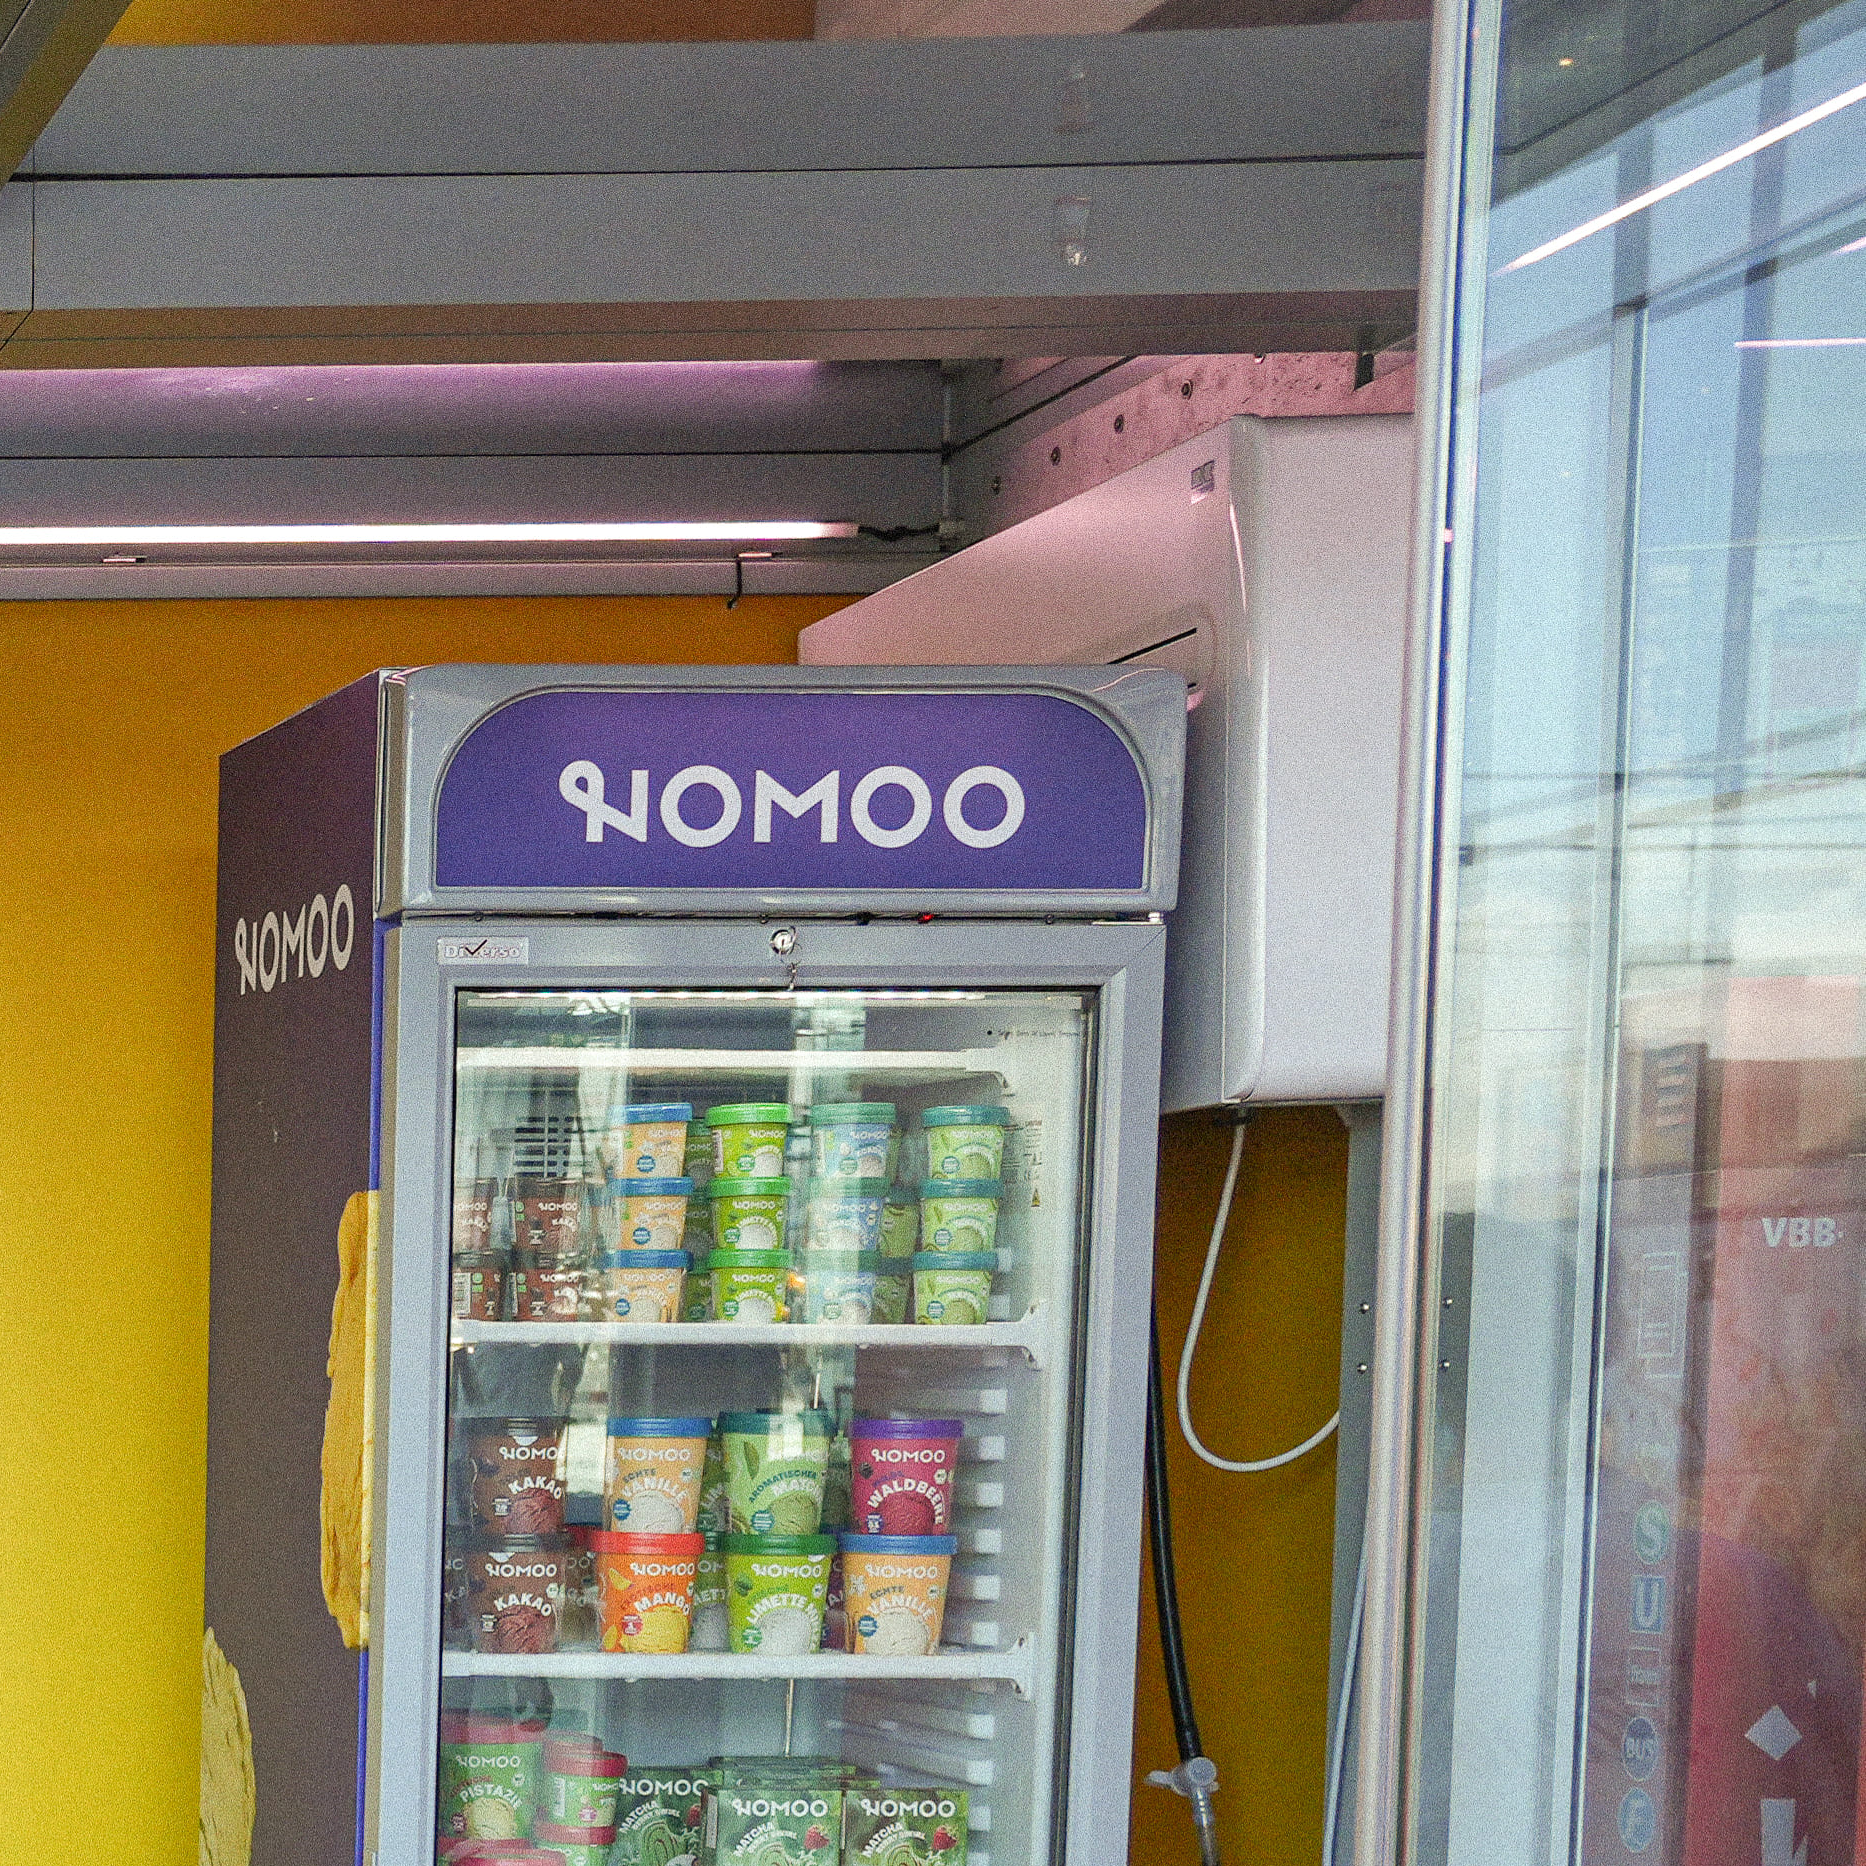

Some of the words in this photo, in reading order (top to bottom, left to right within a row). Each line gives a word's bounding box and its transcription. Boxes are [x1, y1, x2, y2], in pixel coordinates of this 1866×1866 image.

[558, 760, 1025, 848] NOMOO
[235, 884, 355, 996] NOMOO
[1762, 1218, 1837, 1248] VBB
[500, 1446, 559, 1460] NOMO
[619, 1448, 691, 1461] NOMOO
[872, 1449, 945, 1463] NOMOO
[508, 1476, 562, 1500] KAKAO
[867, 1478, 944, 1525] WALDBEERE
[485, 1563, 557, 1577] NOMOO
[630, 1563, 695, 1577] NOMOO
[752, 1563, 823, 1577] NOMOO
[865, 1564, 938, 1578] NOMOO
[494, 1592, 552, 1617] KAKAO
[634, 1592, 690, 1616] MANGO
[746, 1594, 807, 1625] LIMETTE
[456, 1755, 521, 1768] NOMOO
[459, 1783, 523, 1809] PISTAZIE
[732, 1799, 829, 1818] NOMOO
[861, 1799, 957, 1818] NOMOO
